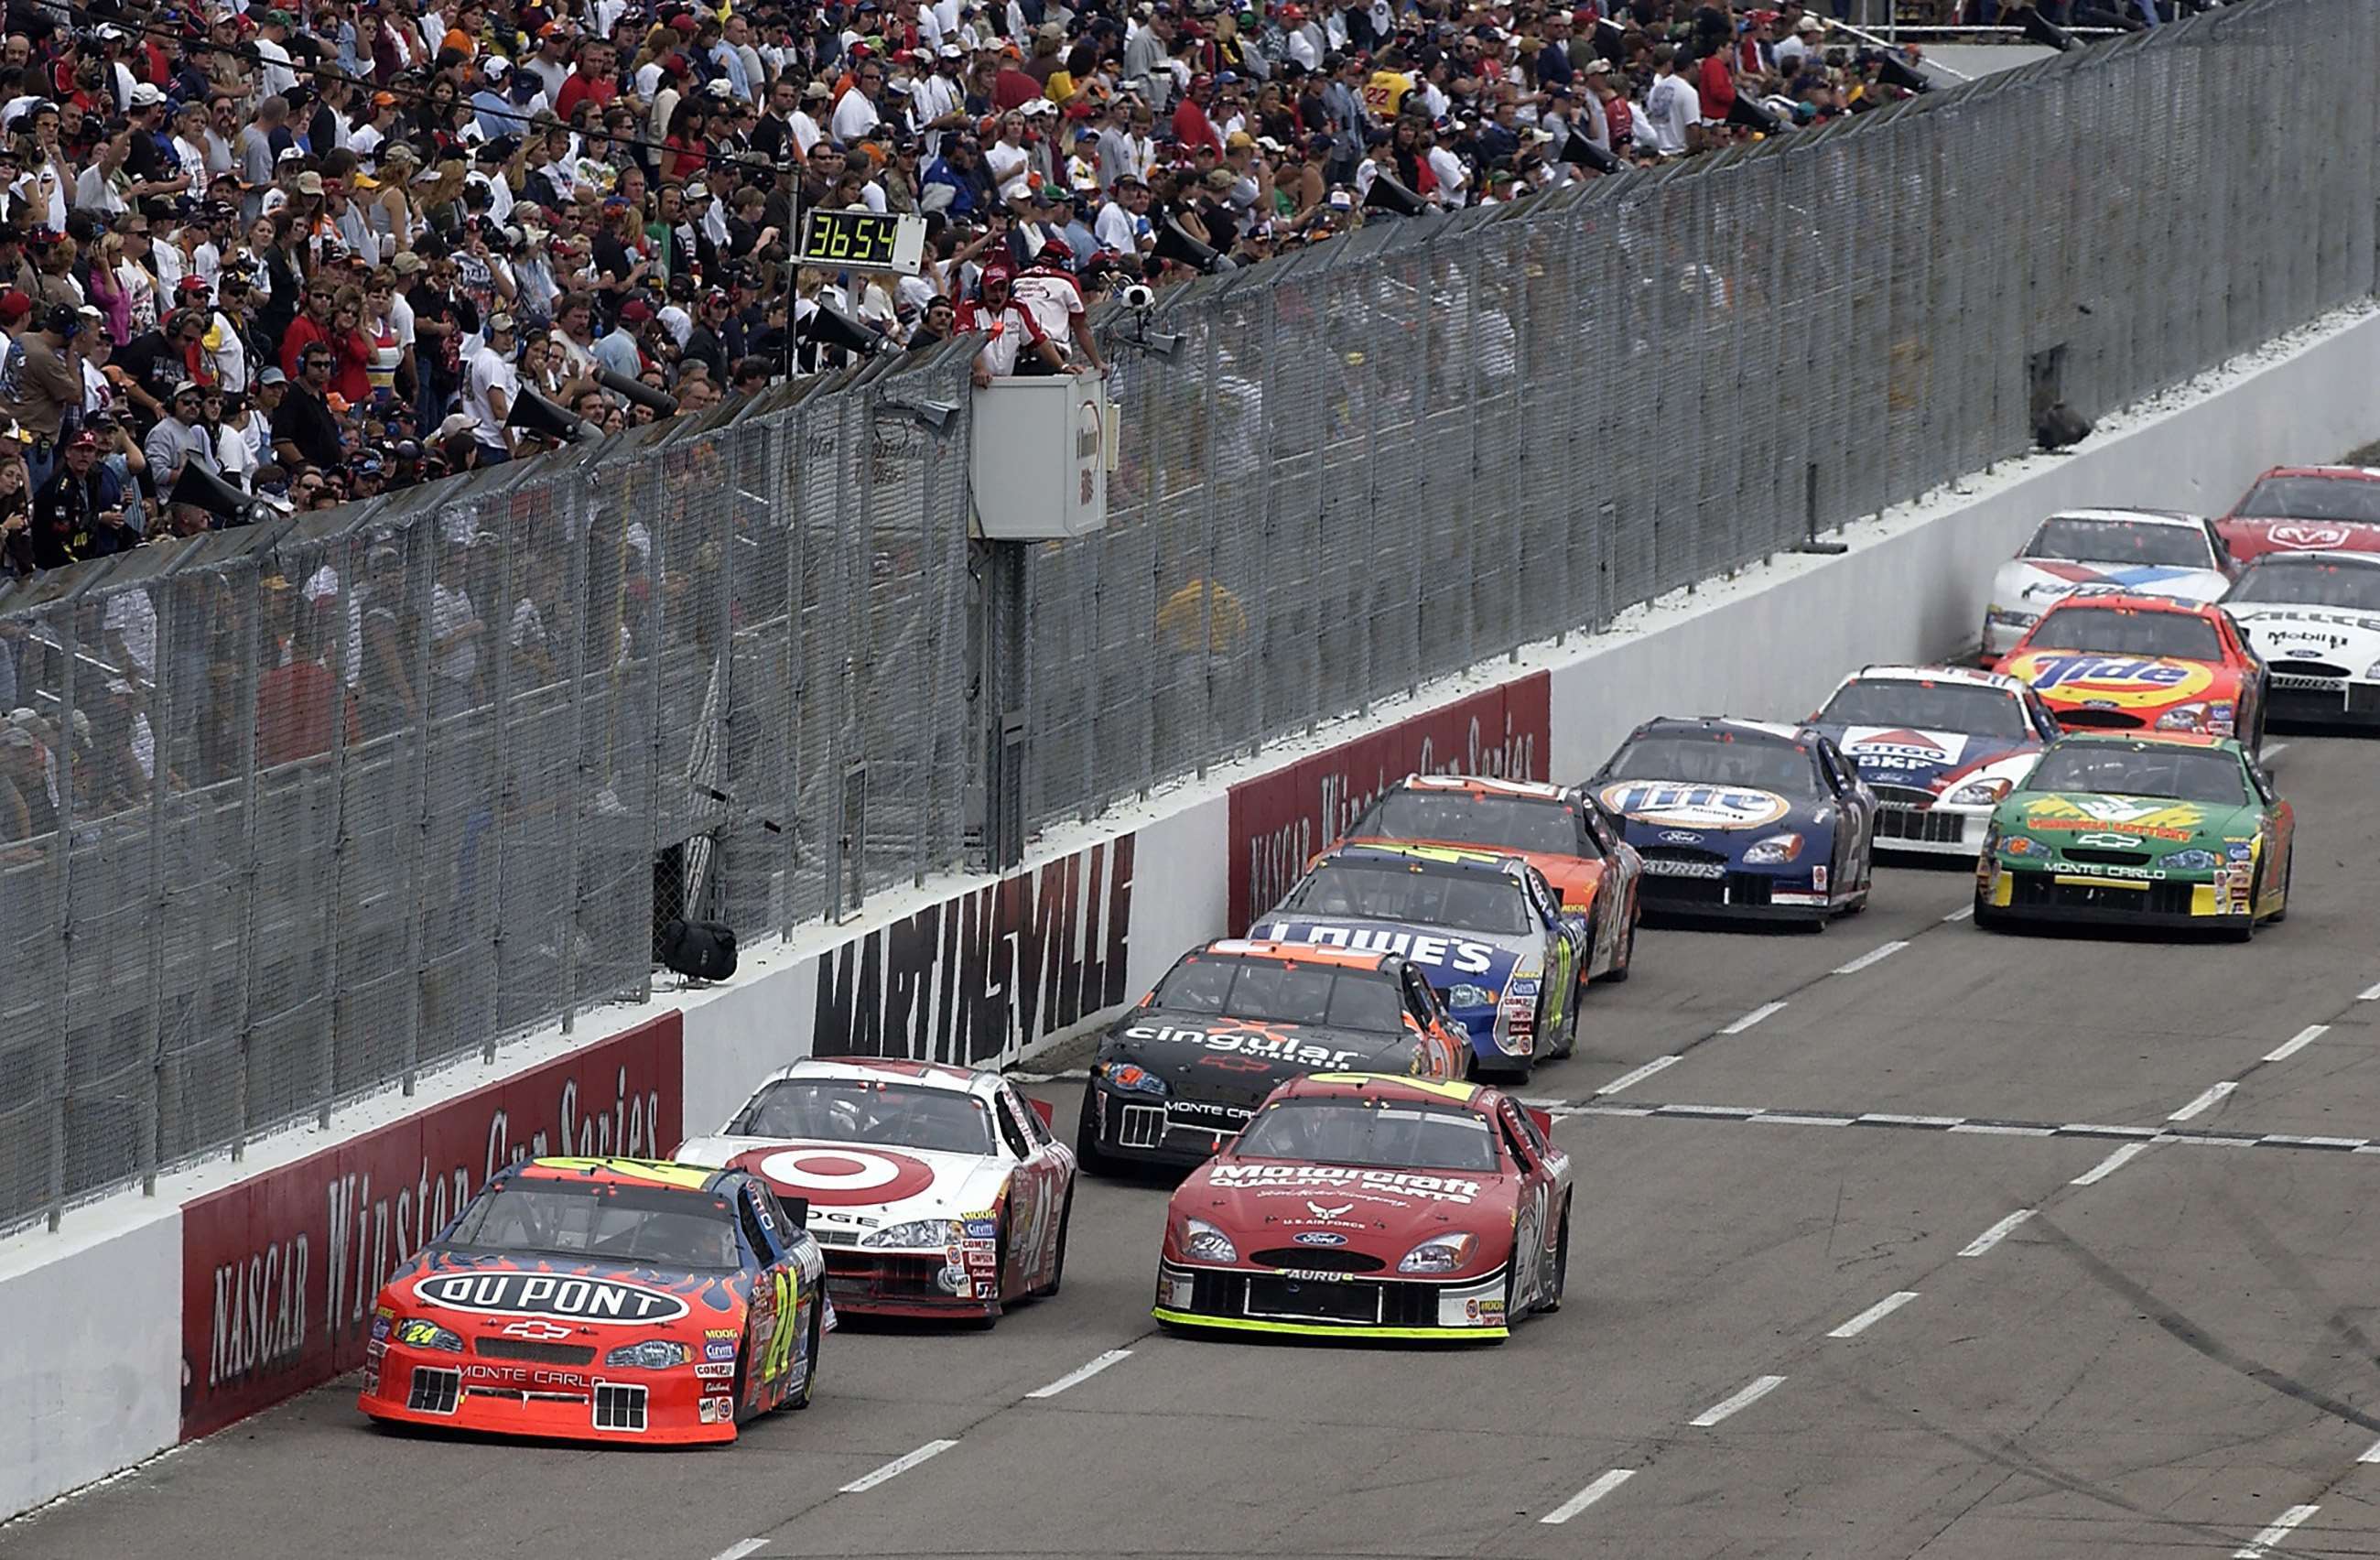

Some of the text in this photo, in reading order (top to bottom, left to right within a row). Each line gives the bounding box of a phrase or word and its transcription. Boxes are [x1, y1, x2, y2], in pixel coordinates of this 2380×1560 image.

[1367, 87, 1390, 105] 22
[2033, 655, 2190, 689] Tide
[2272, 677, 2346, 691] AURUS
[1852, 744, 1946, 760] CITGO
[1643, 861, 1726, 879] AURUS
[2043, 862, 2167, 880] MONTE CARLO
[1125, 1026, 1359, 1064] cingular
[1163, 1101, 1223, 1116] MONTE
[1210, 1165, 1481, 1196] Motorcraft
[1208, 1177, 1472, 1205] QUALITY PARTS
[806, 1210, 880, 1229] DGE
[1303, 1234, 1338, 1244] Ford
[440, 1273, 663, 1316] DU PONT
[210, 1232, 309, 1387] NASCAR
[406, 1324, 439, 1344] 24
[705, 1328, 738, 1340] MOOG
[456, 1364, 606, 1388] MONTE CARLO
